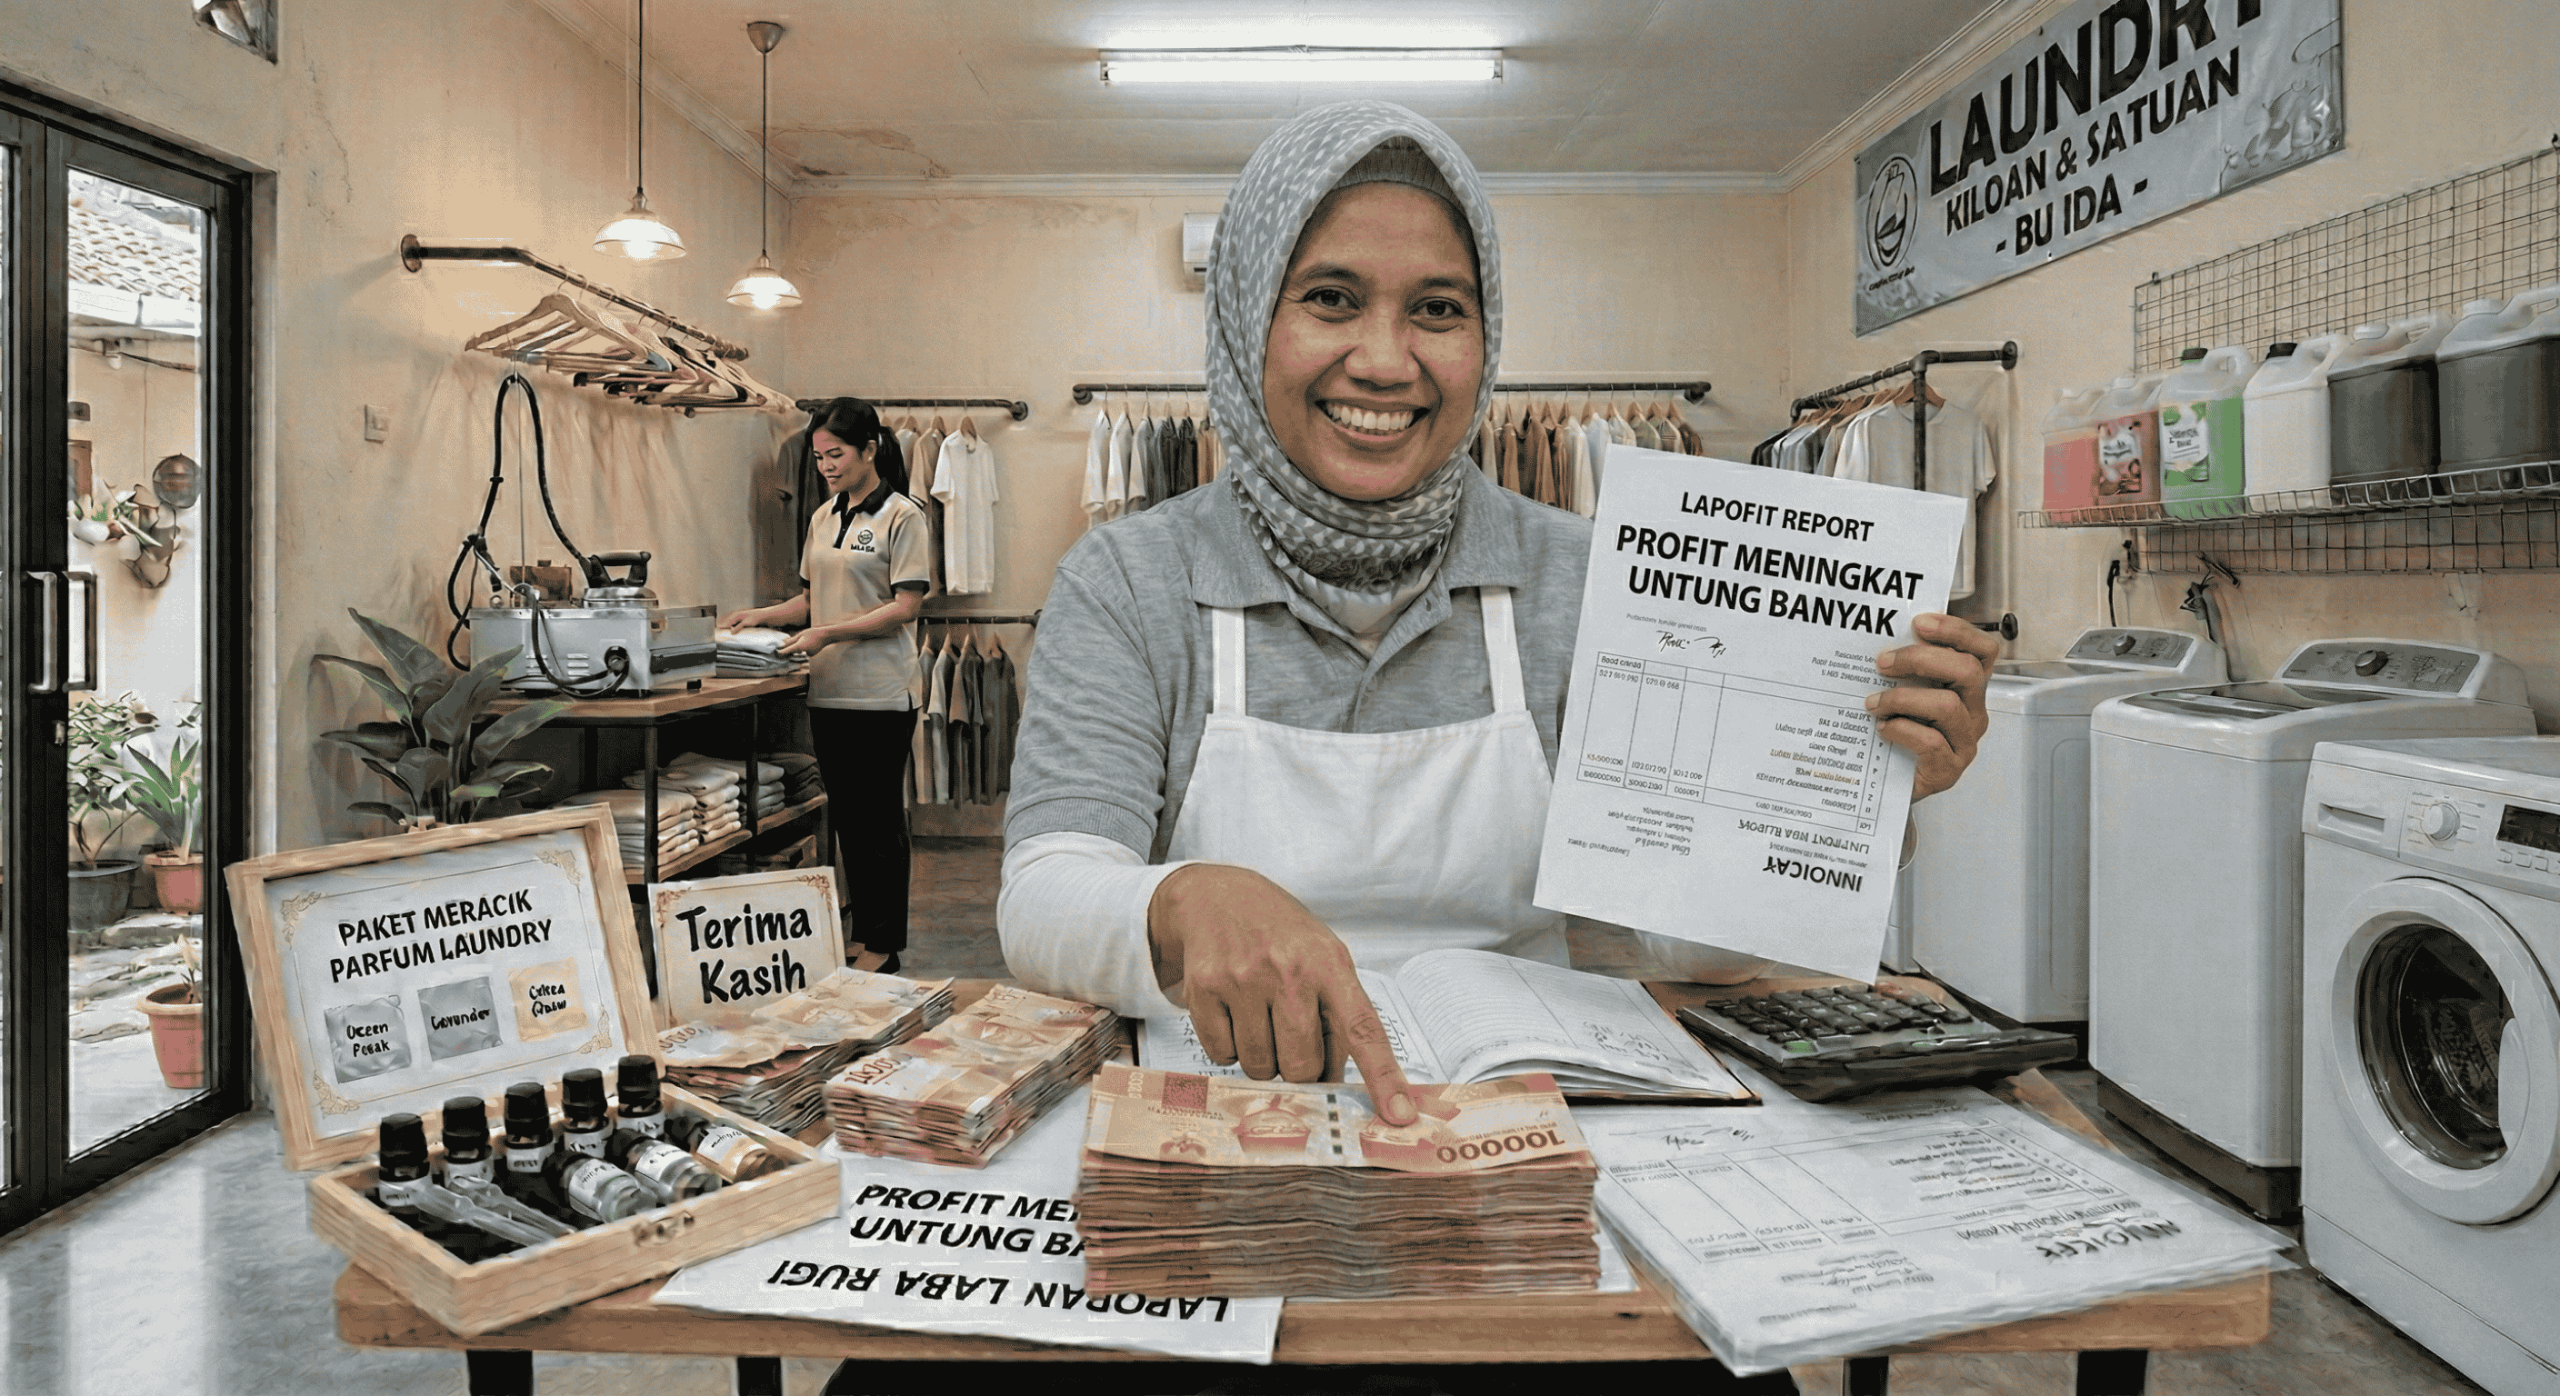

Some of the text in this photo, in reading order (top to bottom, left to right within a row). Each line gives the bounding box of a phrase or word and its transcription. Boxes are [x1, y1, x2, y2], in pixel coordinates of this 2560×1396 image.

[1930, 0, 2261, 197] LAUNDR
[1946, 45, 2239, 236] KILOAN & SATUAN
[2015, 202, 2054, 256] BU
[2063, 173, 2123, 236] IDA
[1681, 491, 1875, 542] LAPOFIT REPORT
[1616, 524, 1924, 600] PROFIT MENINGKAT
[1628, 565, 1898, 637] UNTUNG BANYAK
[338, 889, 533, 946] PAKET MERACIK
[675, 903, 813, 952] Terima
[330, 918, 552, 983] PARFUM LAUNDRY
[699, 948, 806, 1005] Kasih
[1435, 1129, 1566, 1164] 100000
[855, 1184, 1079, 1222] PROFIT ME
[850, 1216, 1036, 1253] UNTUNG
[767, 1260, 881, 1292] RUGI
[894, 1270, 1010, 1305] LABA
